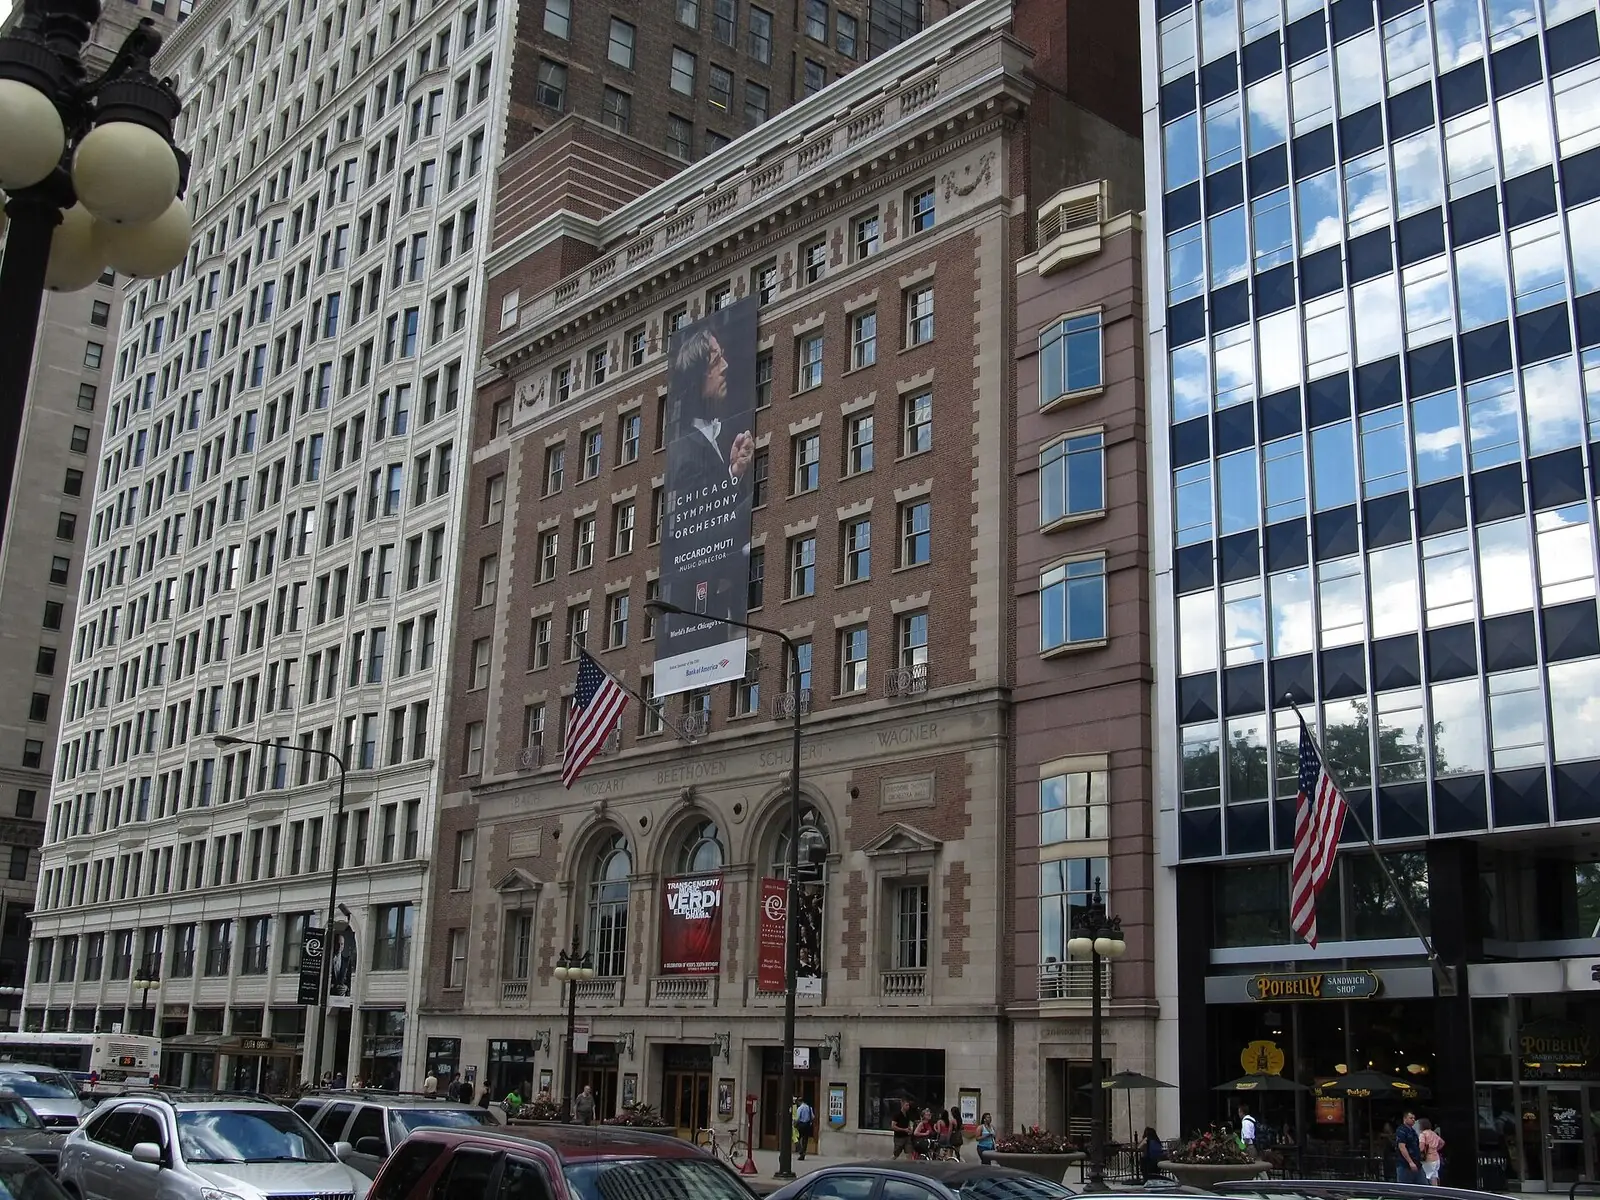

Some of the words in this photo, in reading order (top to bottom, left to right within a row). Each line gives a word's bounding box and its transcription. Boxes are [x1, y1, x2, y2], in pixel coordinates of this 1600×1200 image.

[677, 476, 738, 506] CHICAGO
[676, 493, 738, 523] SYMPHONY
[675, 511, 737, 539] ORCHESTRA
[674, 545, 712, 564] RICCARDO
[714, 538, 734, 552] MUTI
[679, 561, 696, 572] MUSIC
[697, 552, 726, 567] DIRECTOR
[670, 629, 686, 638] World's
[697, 620, 718, 630] Chicago's
[686, 668, 696, 676] Bank
[700, 663, 719, 674] America
[877, 723, 938, 747] WAGNER
[760, 743, 824, 767] SCHUERT
[657, 759, 726, 785] BEETHOVEN
[583, 778, 625, 797] MOZART
[667, 879, 720, 889] TRANSCENDENT
[666, 890, 721, 910] VERDI
[685, 912, 711, 920] DRAMA.
[1257, 975, 1323, 999] POTBELLY
[1327, 976, 1365, 985] SANDWICH
[1336, 985, 1356, 994] SHOP
[1521, 1036, 1591, 1056] POTBELLY
[1524, 1068, 1543, 1079] 200
[1347, 1088, 1371, 1097] Potbelly
